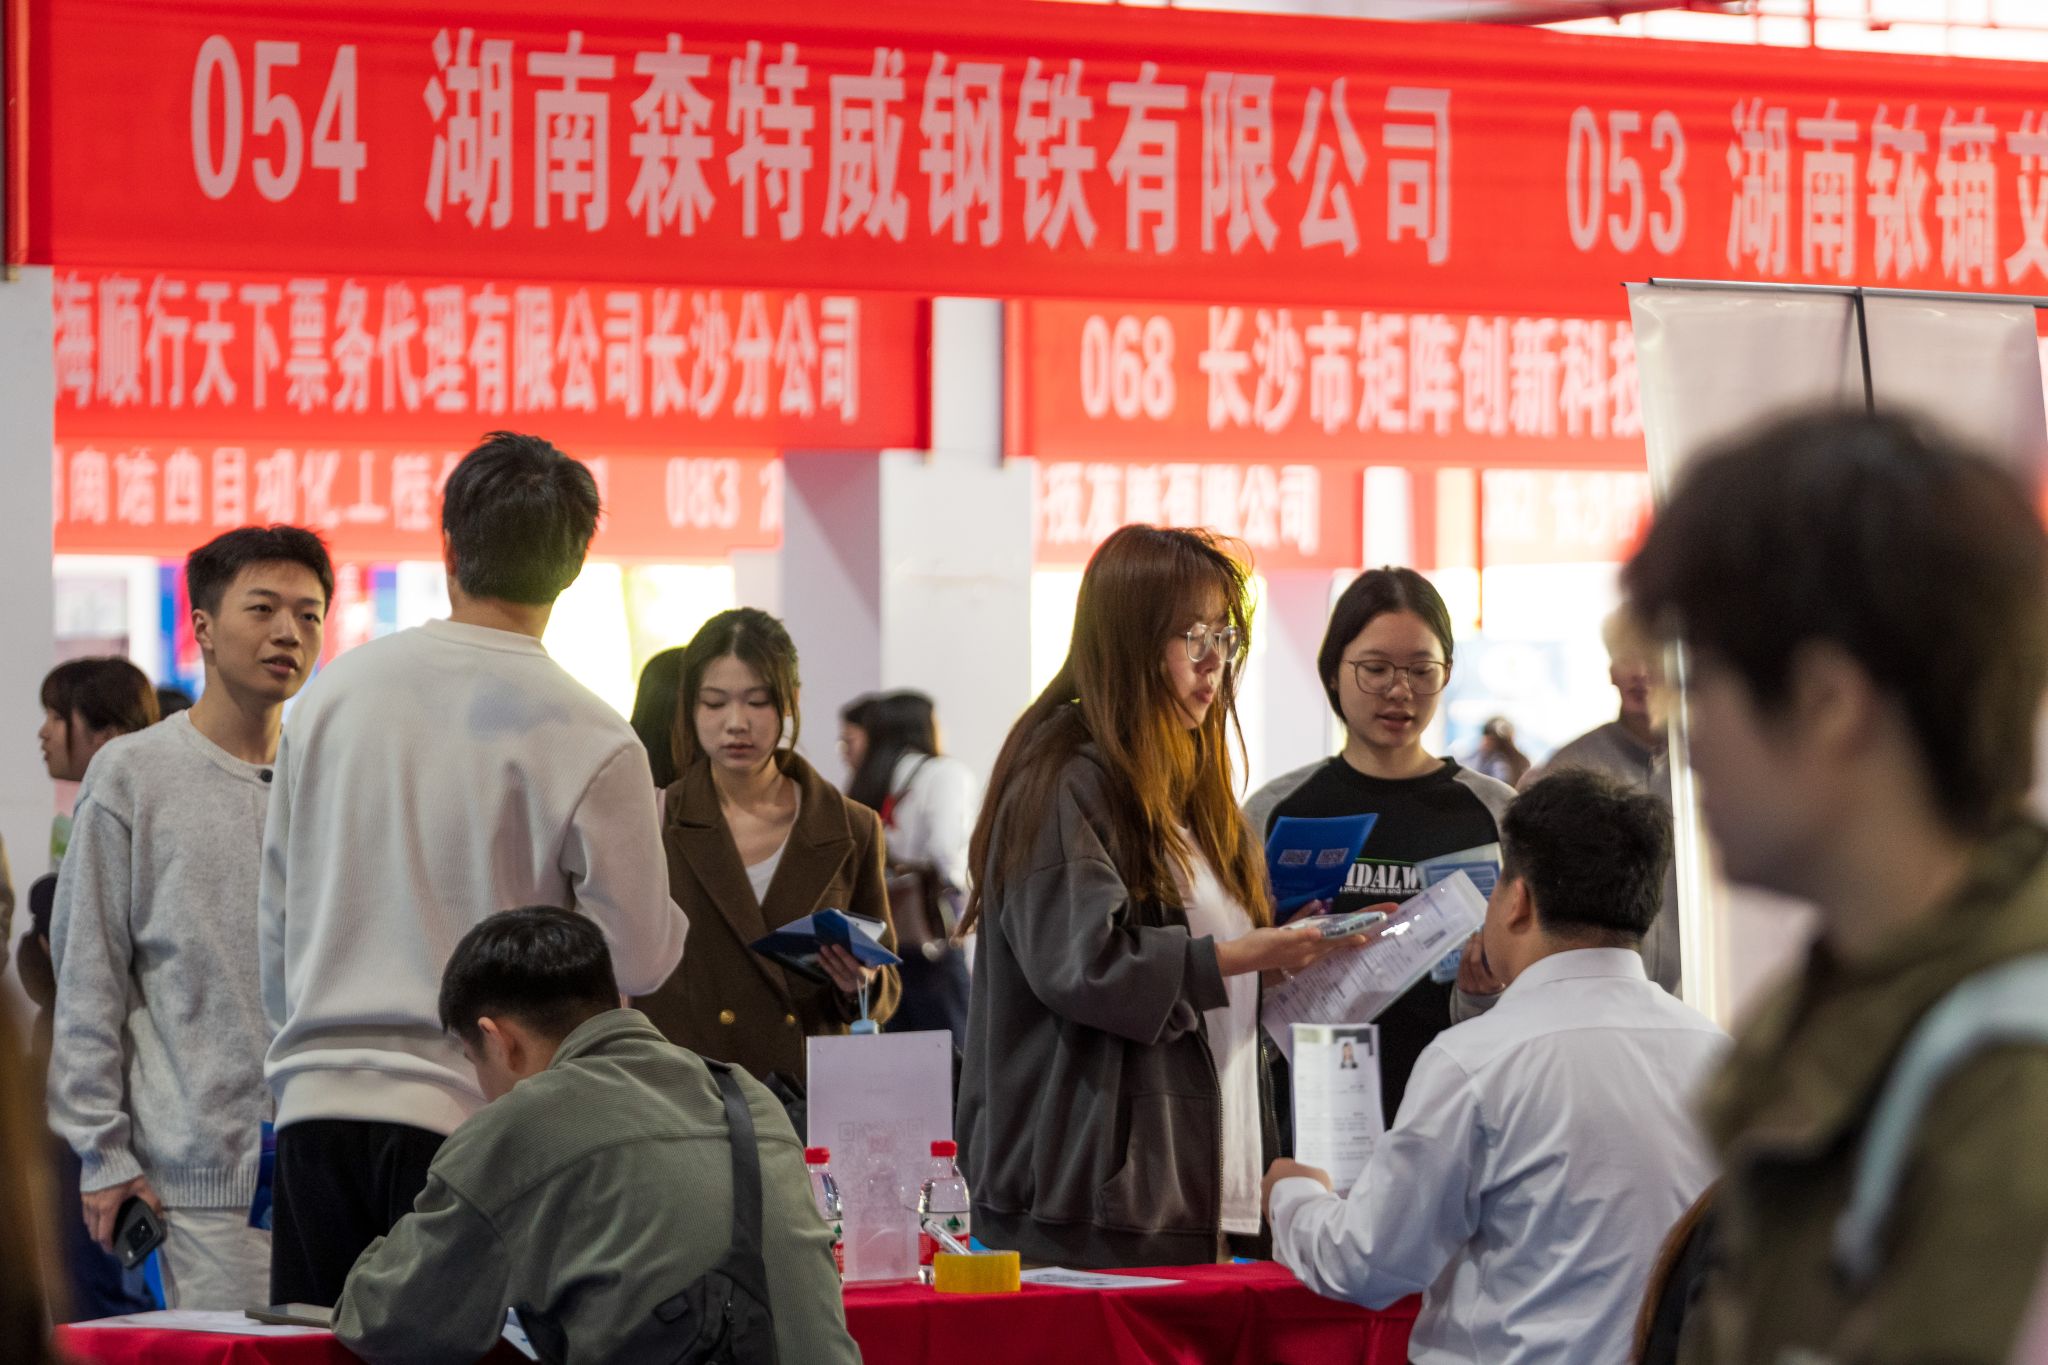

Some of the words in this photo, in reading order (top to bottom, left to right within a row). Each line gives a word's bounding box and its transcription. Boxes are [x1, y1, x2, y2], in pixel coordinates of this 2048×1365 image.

[190, 34, 367, 203] 054
[423, 27, 1453, 265] 湖南森特威钢铁有限公司
[1566, 105, 1688, 255] 053
[1080, 314, 1175, 419] 068
[665, 456, 740, 529] 083
